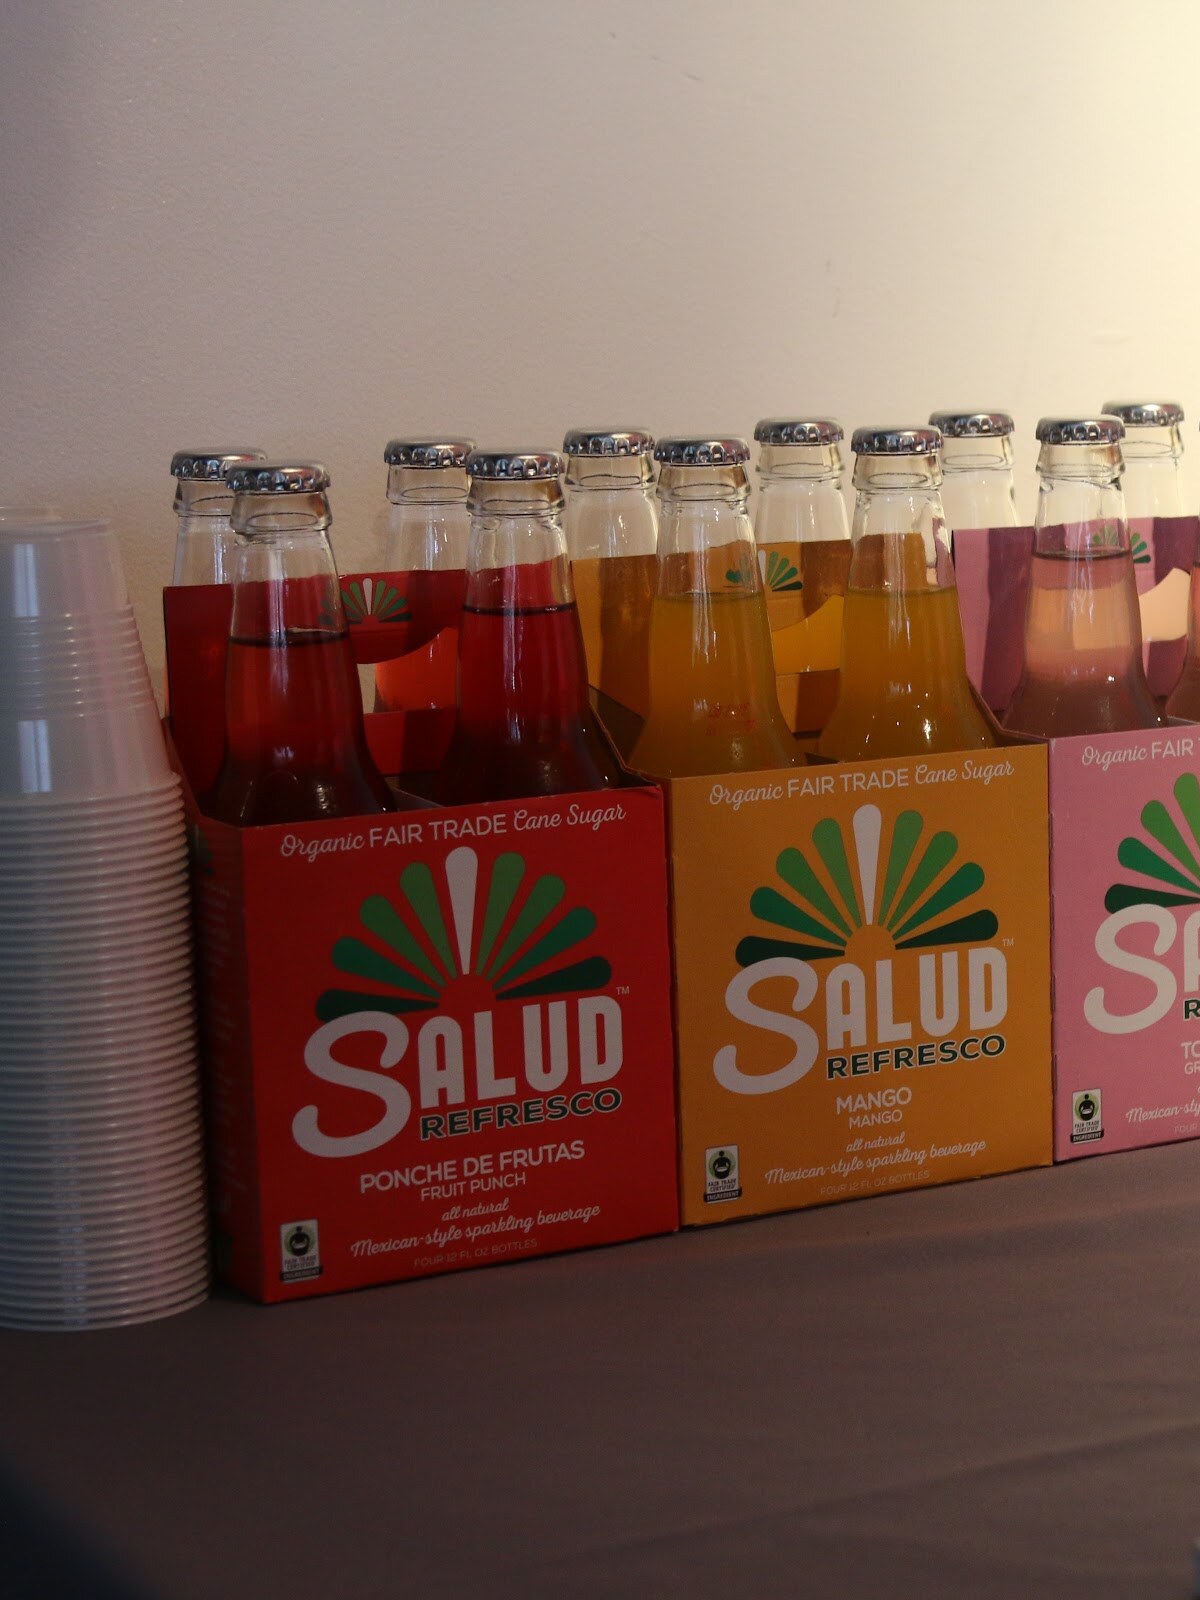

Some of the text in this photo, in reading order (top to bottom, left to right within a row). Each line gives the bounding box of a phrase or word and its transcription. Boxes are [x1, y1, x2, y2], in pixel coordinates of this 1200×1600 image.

[1081, 746, 1147, 771] Organic
[1152, 739, 1193, 760] FAIR
[710, 759, 1015, 811] Organic FAIR TRADE Cane Sugar
[280, 804, 626, 862] Organic FAIR TRADE Cane Sugar
[713, 947, 1008, 1095] SALUD
[292, 994, 623, 1158] SALUD
[826, 1035, 1005, 1080] REFRESCO
[420, 1087, 623, 1141] REFRESCO
[836, 1087, 912, 1115] MANGO
[849, 1110, 902, 1129] MANGO
[765, 1140, 986, 1185] Mexican-style sparkling beverage
[846, 1132, 905, 1152] all natural
[360, 1140, 585, 1193] PONCHE DE FRUTAS
[421, 1172, 526, 1201] FRUIT PUNCH
[889, 1170, 929, 1185] BOTTLES
[351, 1205, 601, 1258] Mexican-style sparkling beverage
[441, 1198, 509, 1222] all natural
[492, 1238, 537, 1255] BOTTLES
